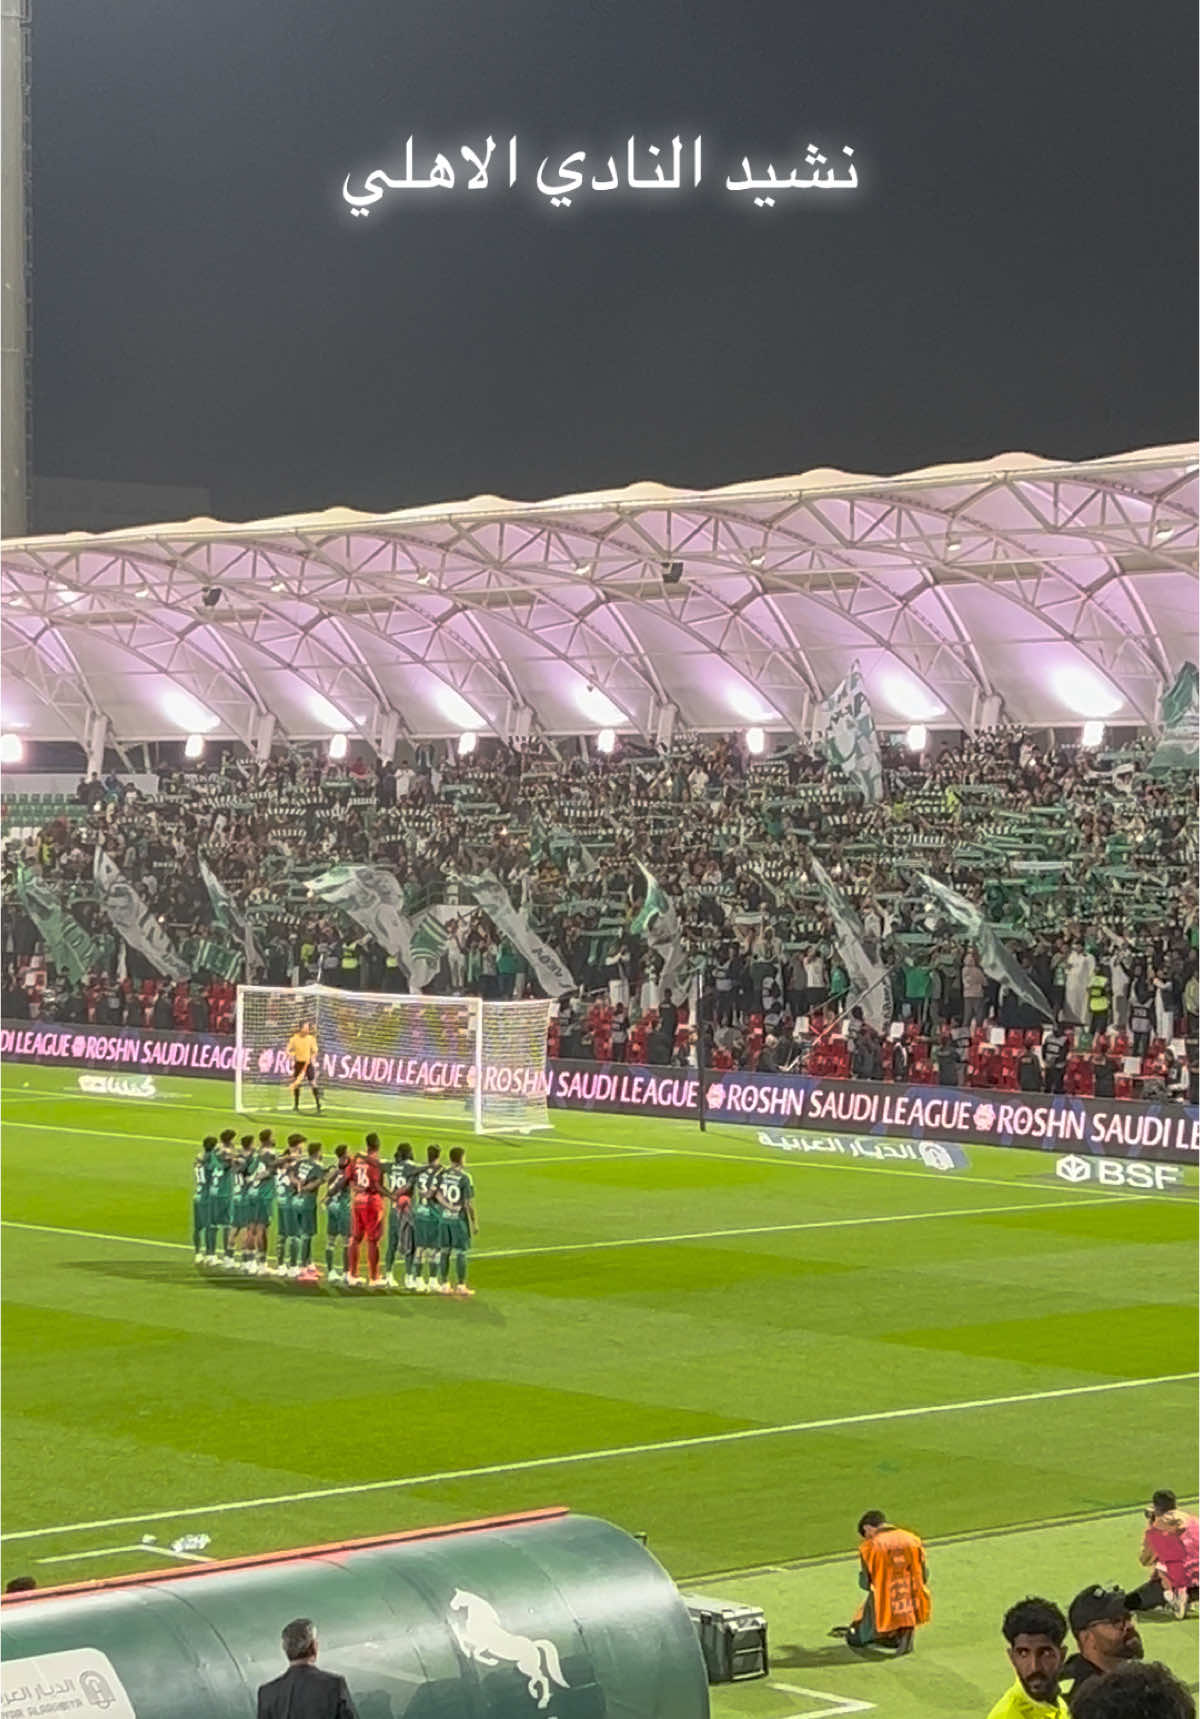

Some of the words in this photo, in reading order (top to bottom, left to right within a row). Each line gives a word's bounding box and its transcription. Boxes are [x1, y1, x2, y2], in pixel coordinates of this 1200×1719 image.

[16, 1031, 71, 1057] LEAGUE
[86, 1036, 139, 1063] ROSHN
[141, 1041, 190, 1066] SAUDI
[338, 1054, 392, 1083] SAUDI
[396, 1057, 467, 1088] LEAGUE
[484, 1066, 554, 1095] ROSHN
[556, 1071, 618, 1101] SAUDI
[621, 1076, 699, 1107] LEAGUE
[726, 1083, 804, 1116] ROSHN
[808, 1090, 878, 1123] SAUDI
[882, 1096, 972, 1130] LEAGUE
[997, 1104, 1086, 1139] ROSHN
[1091, 1113, 1171, 1147] SAUDI
[1099, 1160, 1180, 1189] BSF
[440, 1183, 461, 1204] 10
